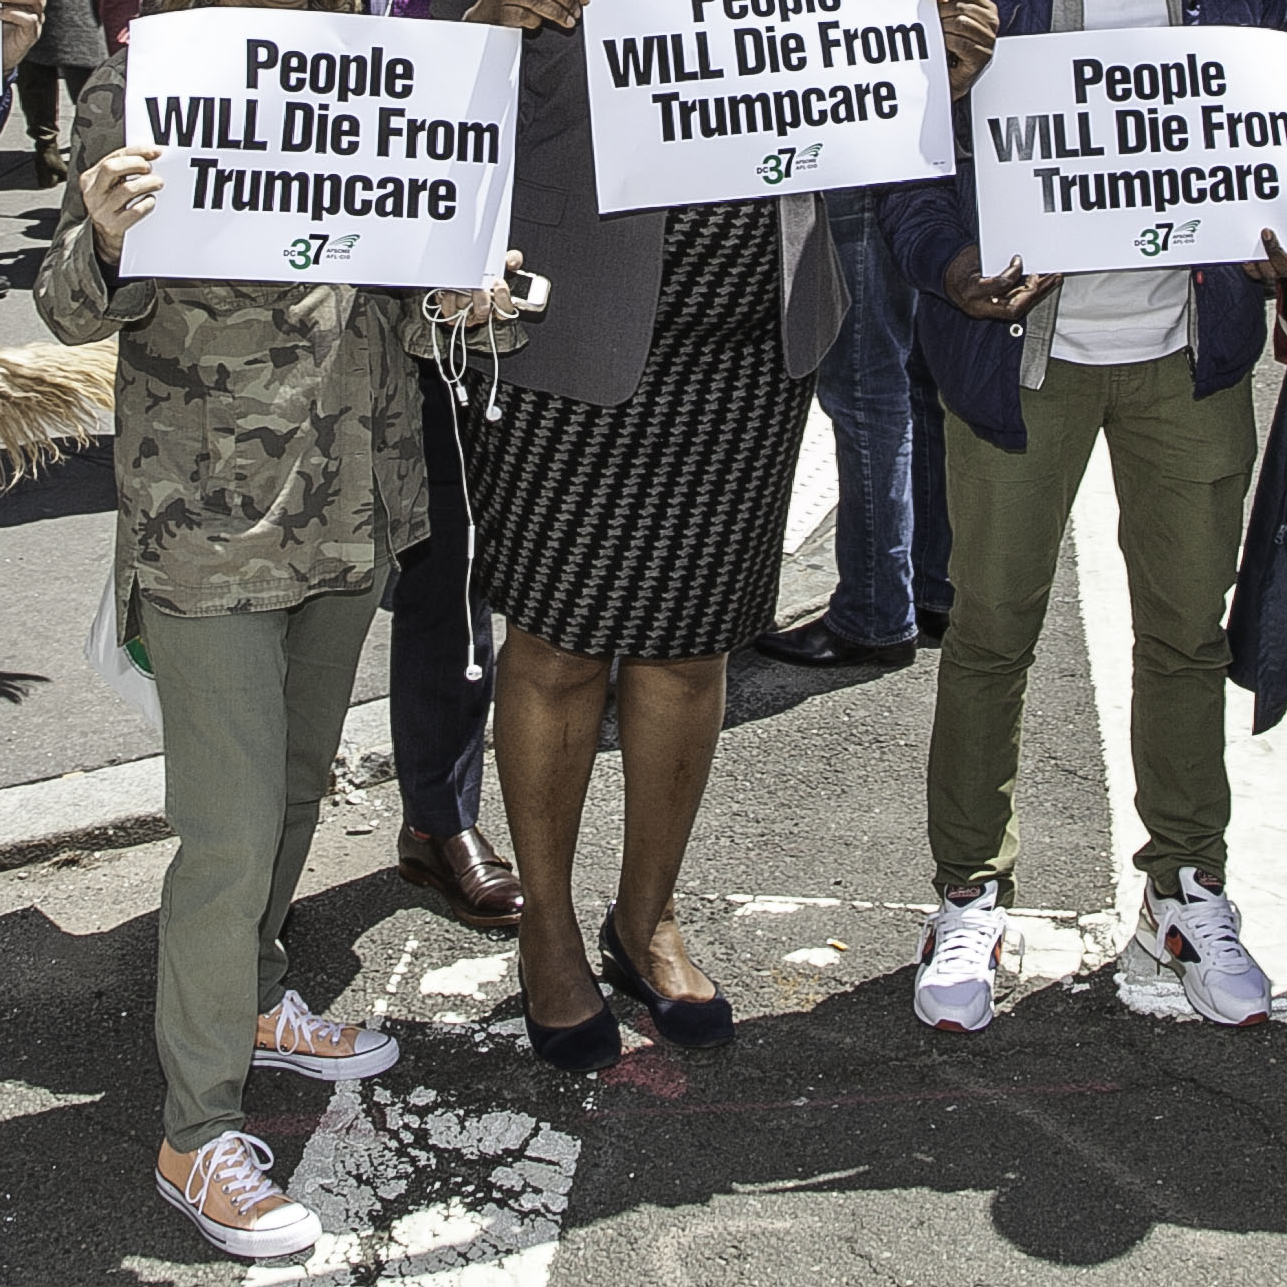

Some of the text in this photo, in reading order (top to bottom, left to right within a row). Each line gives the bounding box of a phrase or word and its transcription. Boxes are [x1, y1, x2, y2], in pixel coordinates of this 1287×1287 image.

[246, 38, 415, 103] People
[603, 19, 929, 89] WILL Die From
[1072, 53, 1227, 106] People
[145, 96, 500, 165] WILL Die From
[652, 80, 899, 143] Trumpcare
[988, 111, 1105, 163] WILL
[1115, 107, 1189, 155] Die
[189, 157, 458, 222] Trumpcare
[1033, 161, 1281, 214] Trumpcare
